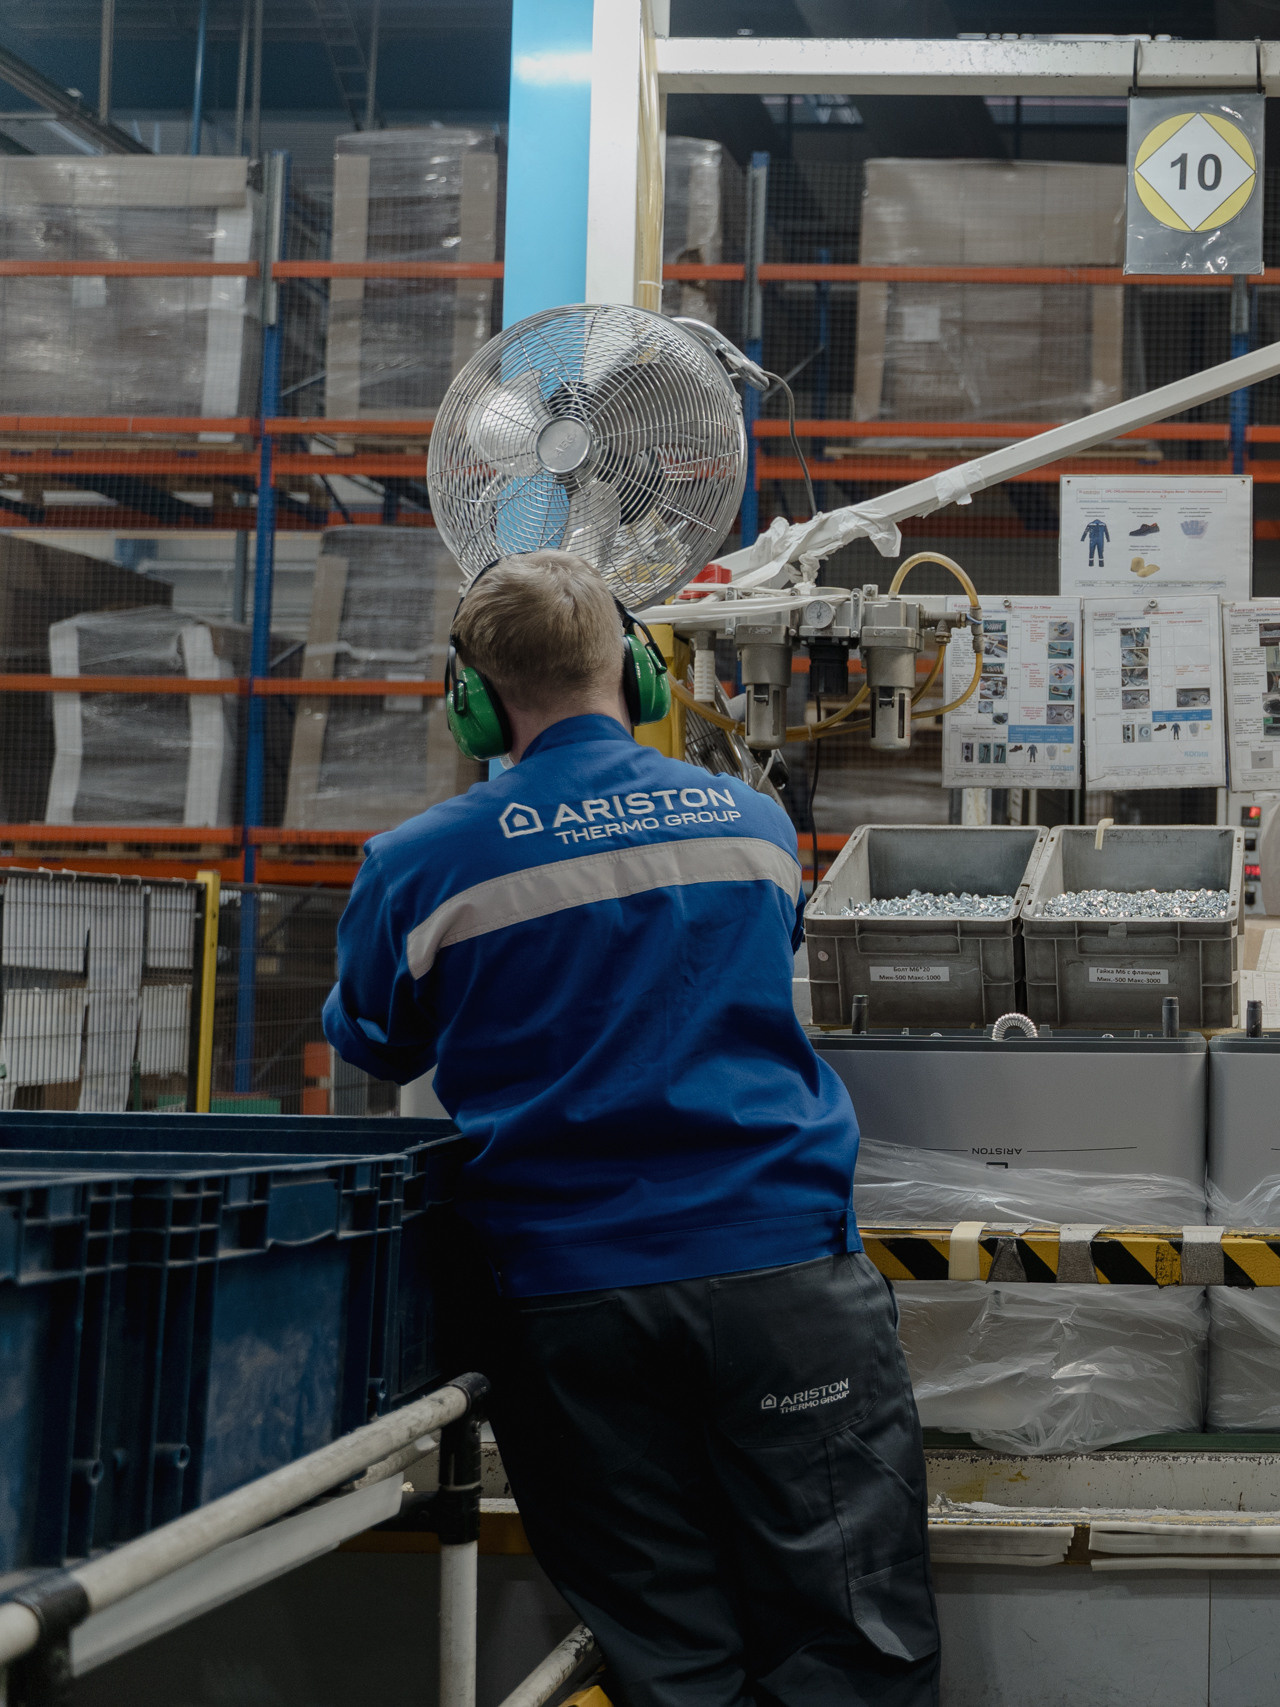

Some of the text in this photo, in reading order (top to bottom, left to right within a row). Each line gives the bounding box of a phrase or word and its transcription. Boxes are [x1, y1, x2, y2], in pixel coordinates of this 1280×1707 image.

[1170, 152, 1222, 191] 10
[552, 788, 736, 828] ARISTON
[554, 810, 742, 845] THERMO GROUP
[971, 1147, 1023, 1155] ARISTON
[780, 1377, 849, 1407] ARISTON
[780, 1390, 850, 1414] THERMO GROUP
